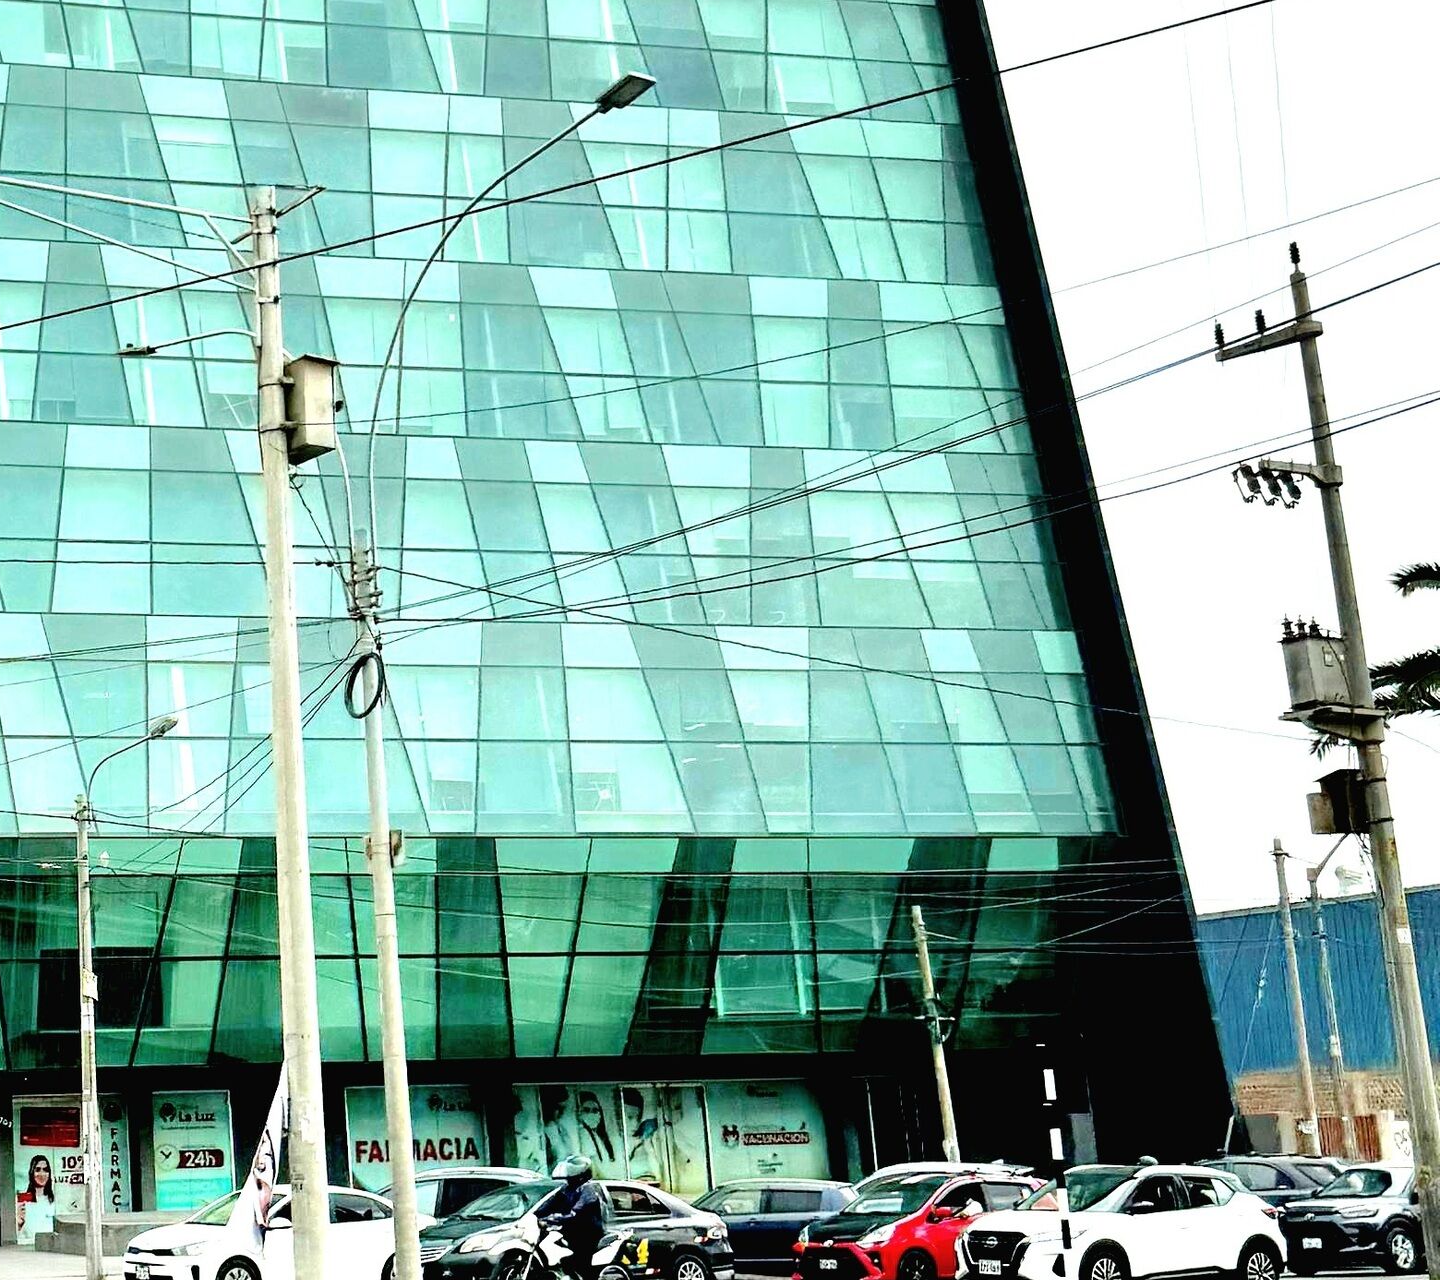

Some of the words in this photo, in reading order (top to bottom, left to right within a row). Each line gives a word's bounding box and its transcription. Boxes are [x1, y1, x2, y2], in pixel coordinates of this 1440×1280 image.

[184, 1151, 216, 1167] 24h
[355, 1137, 480, 1163] FAACIA
[110, 1127, 122, 1213] FARMACI
